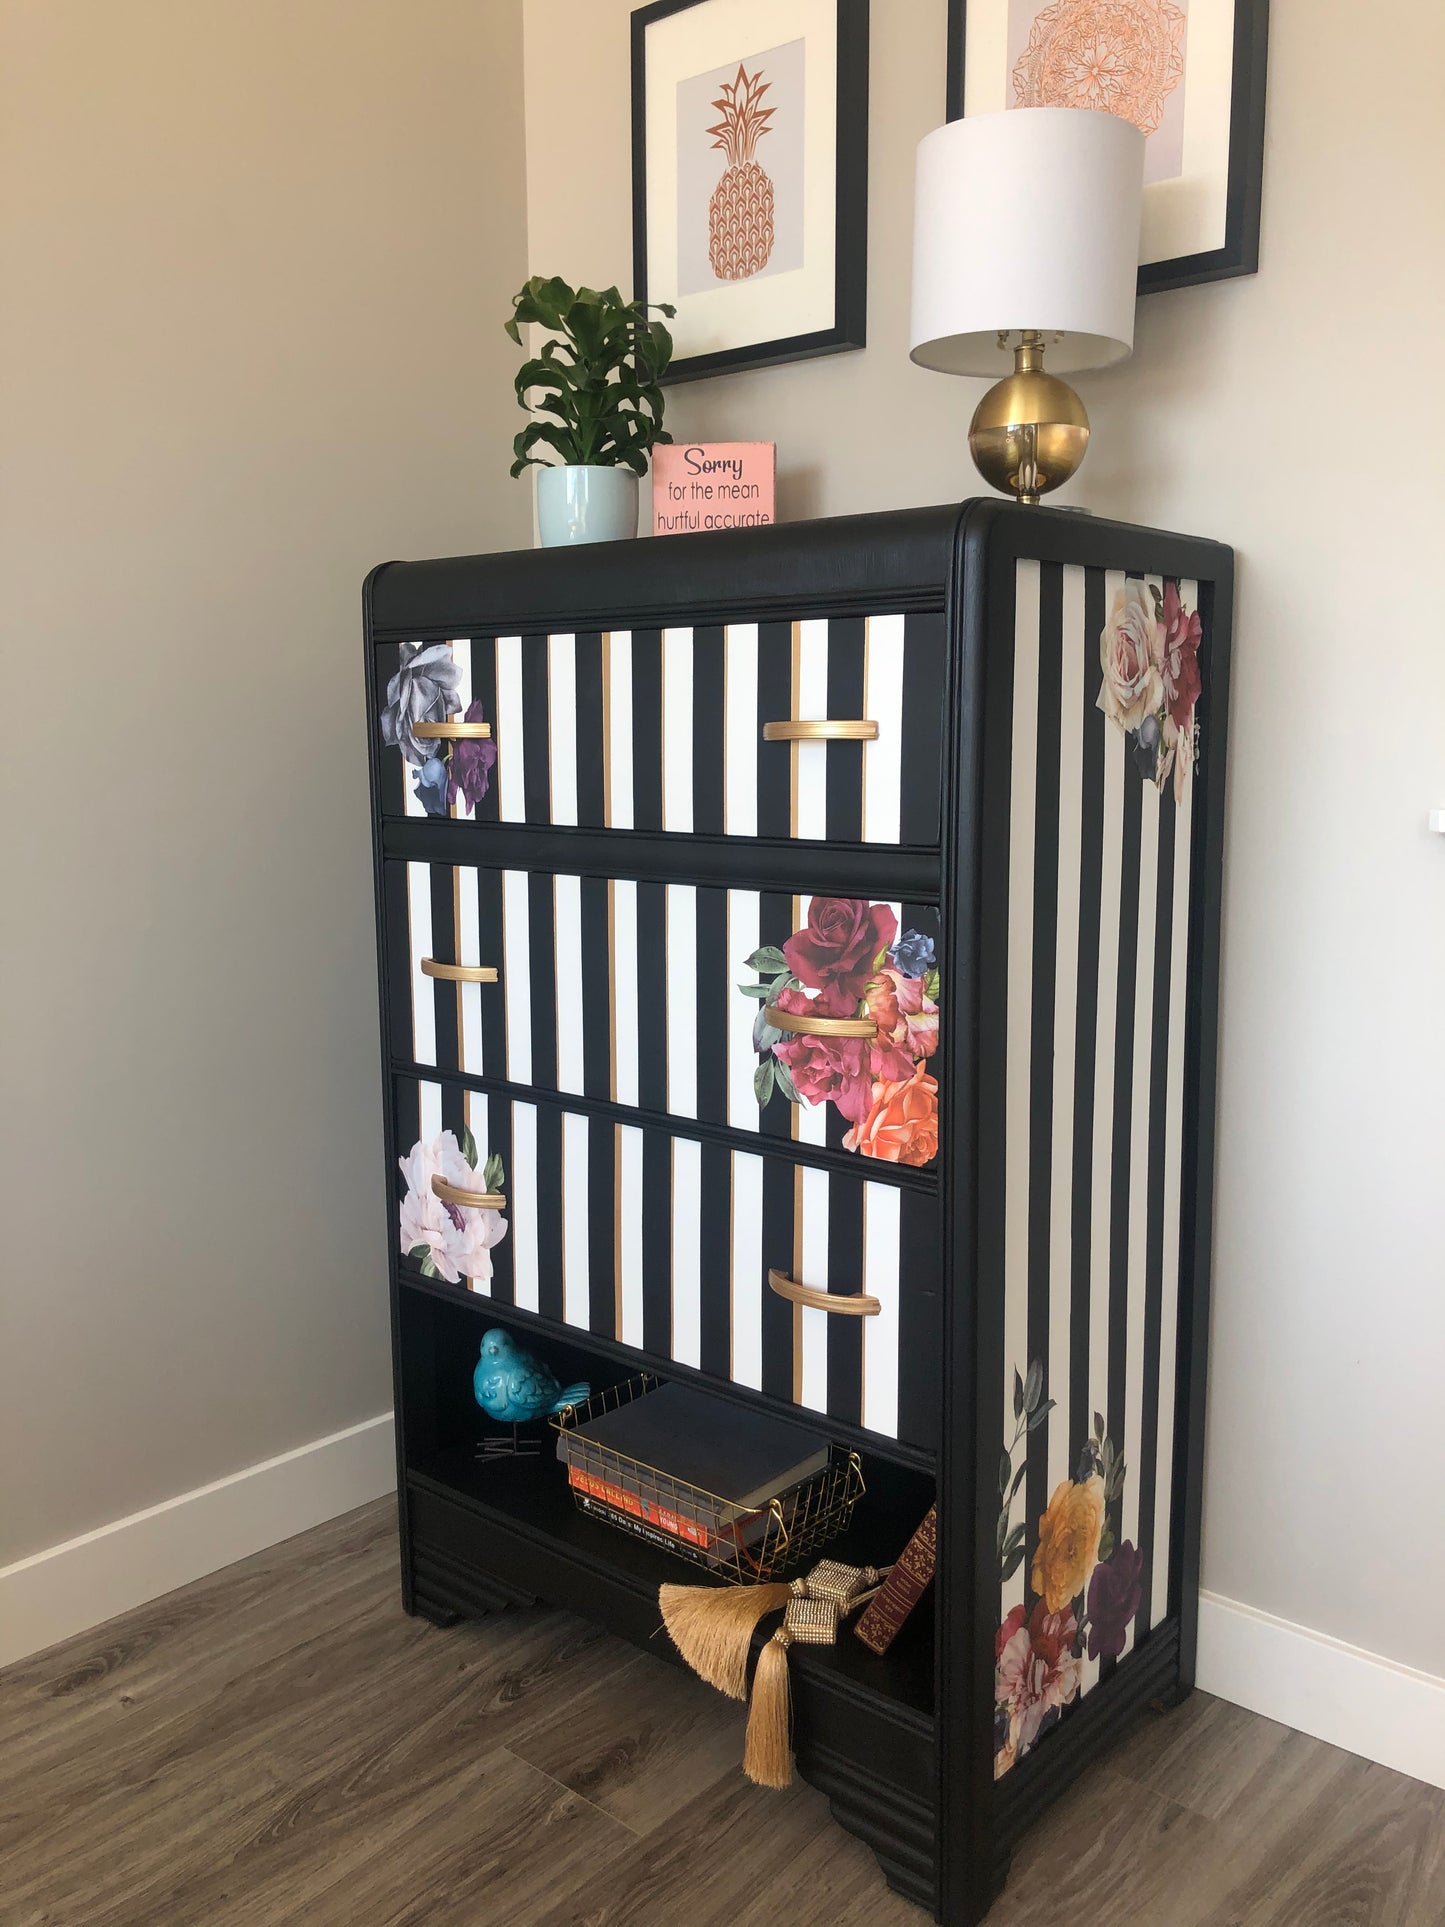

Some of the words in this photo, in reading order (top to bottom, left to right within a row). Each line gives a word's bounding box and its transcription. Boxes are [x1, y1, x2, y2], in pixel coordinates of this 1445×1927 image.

[684, 447, 743, 480] Sorry
[668, 482, 687, 501] for
[691, 482, 714, 500] the
[718, 484, 760, 499] mean
[657, 511, 700, 530] hurtful
[704, 510, 770, 529] accurate
[660, 1516, 678, 1531] YOUNG
